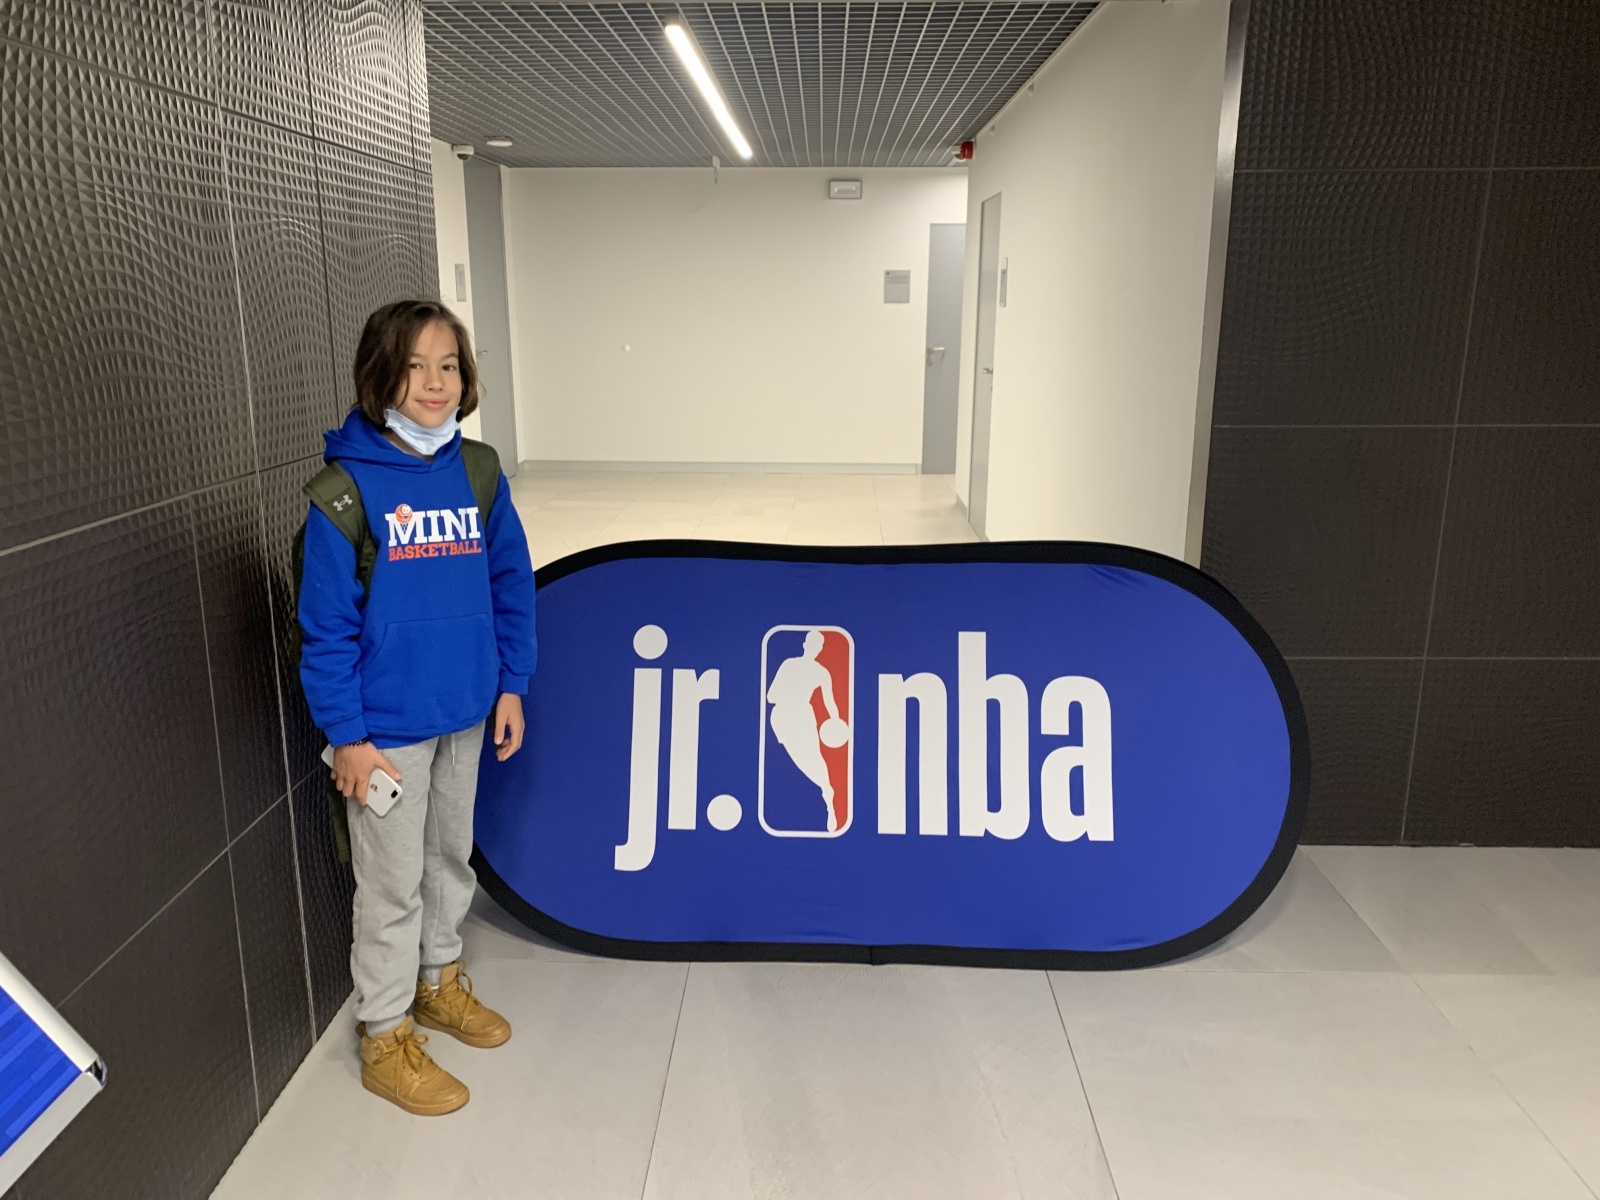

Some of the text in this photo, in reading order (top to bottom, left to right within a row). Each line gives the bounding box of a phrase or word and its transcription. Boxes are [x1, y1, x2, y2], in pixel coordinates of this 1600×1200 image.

[386, 507, 481, 546] MINI
[388, 541, 482, 561] BASKETBALL
[614, 624, 1115, 872] jr. nba
